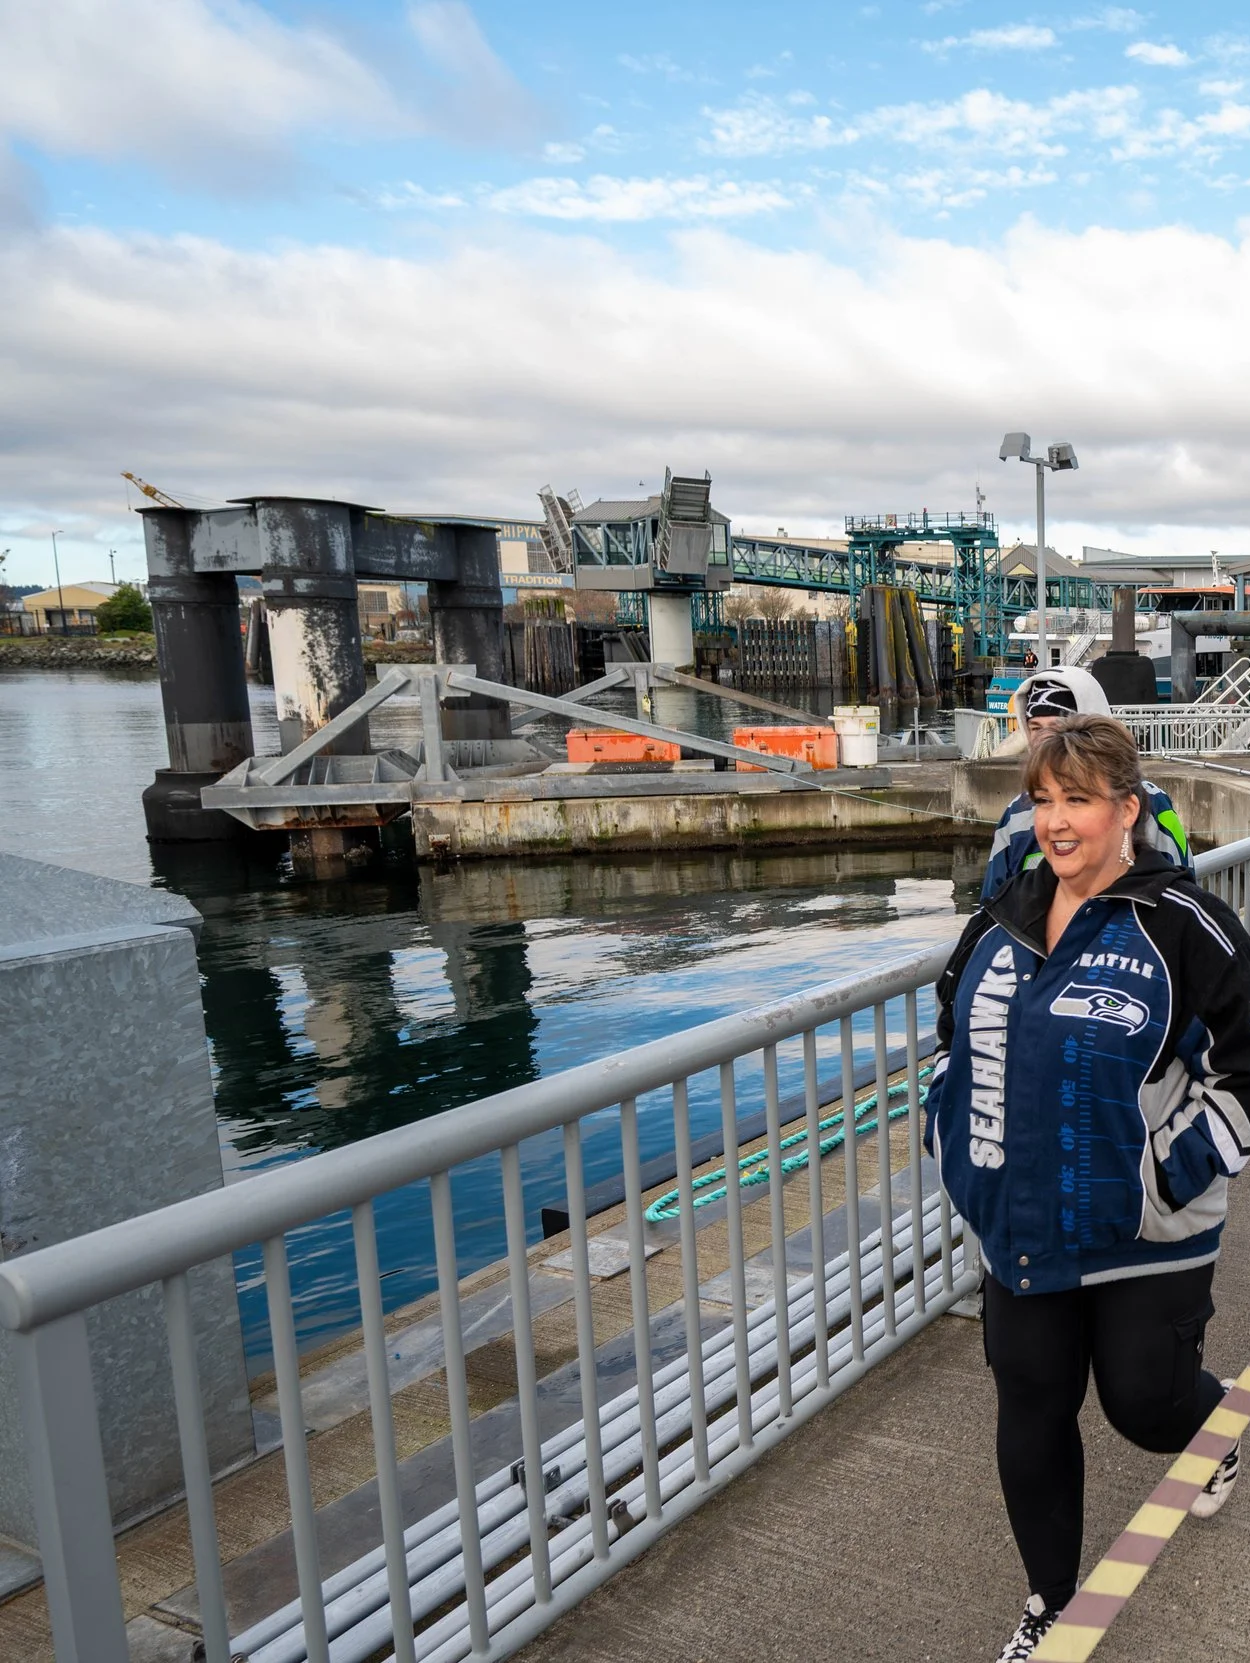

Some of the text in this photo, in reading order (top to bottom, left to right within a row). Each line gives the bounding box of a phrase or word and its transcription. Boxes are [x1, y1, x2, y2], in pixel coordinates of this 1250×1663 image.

[495, 525, 541, 538] SHIPYA
[503, 575, 562, 585] TRADITION
[1070, 953, 1154, 979] EATTLE
[969, 945, 1018, 1170] SEAHAWKS
[1060, 1034, 1078, 1064] 40
[1060, 1079, 1076, 1107] 50
[1060, 1124, 1076, 1151] 40
[1060, 1164, 1076, 1194] 30
